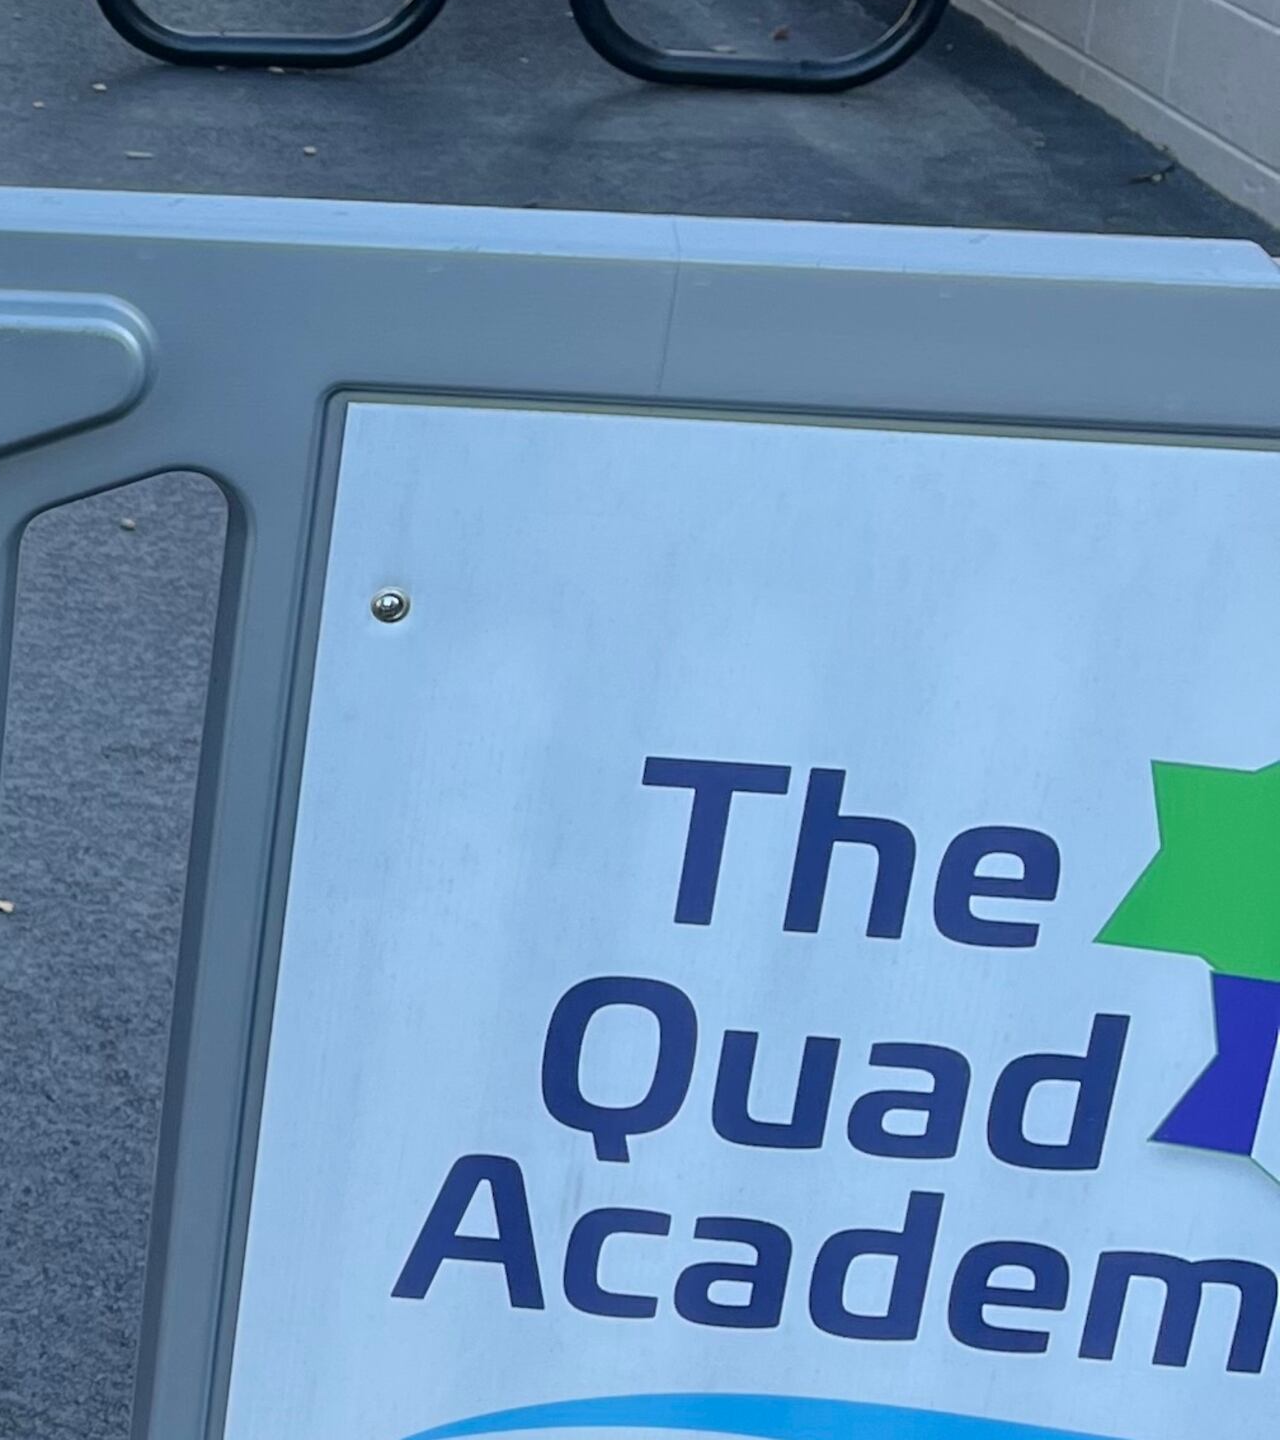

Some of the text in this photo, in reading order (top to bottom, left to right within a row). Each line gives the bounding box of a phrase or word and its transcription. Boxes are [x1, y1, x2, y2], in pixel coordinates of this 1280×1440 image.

[641, 756, 1060, 948] The
[540, 975, 1131, 1170] Quad
[391, 1153, 1279, 1374] Academ
